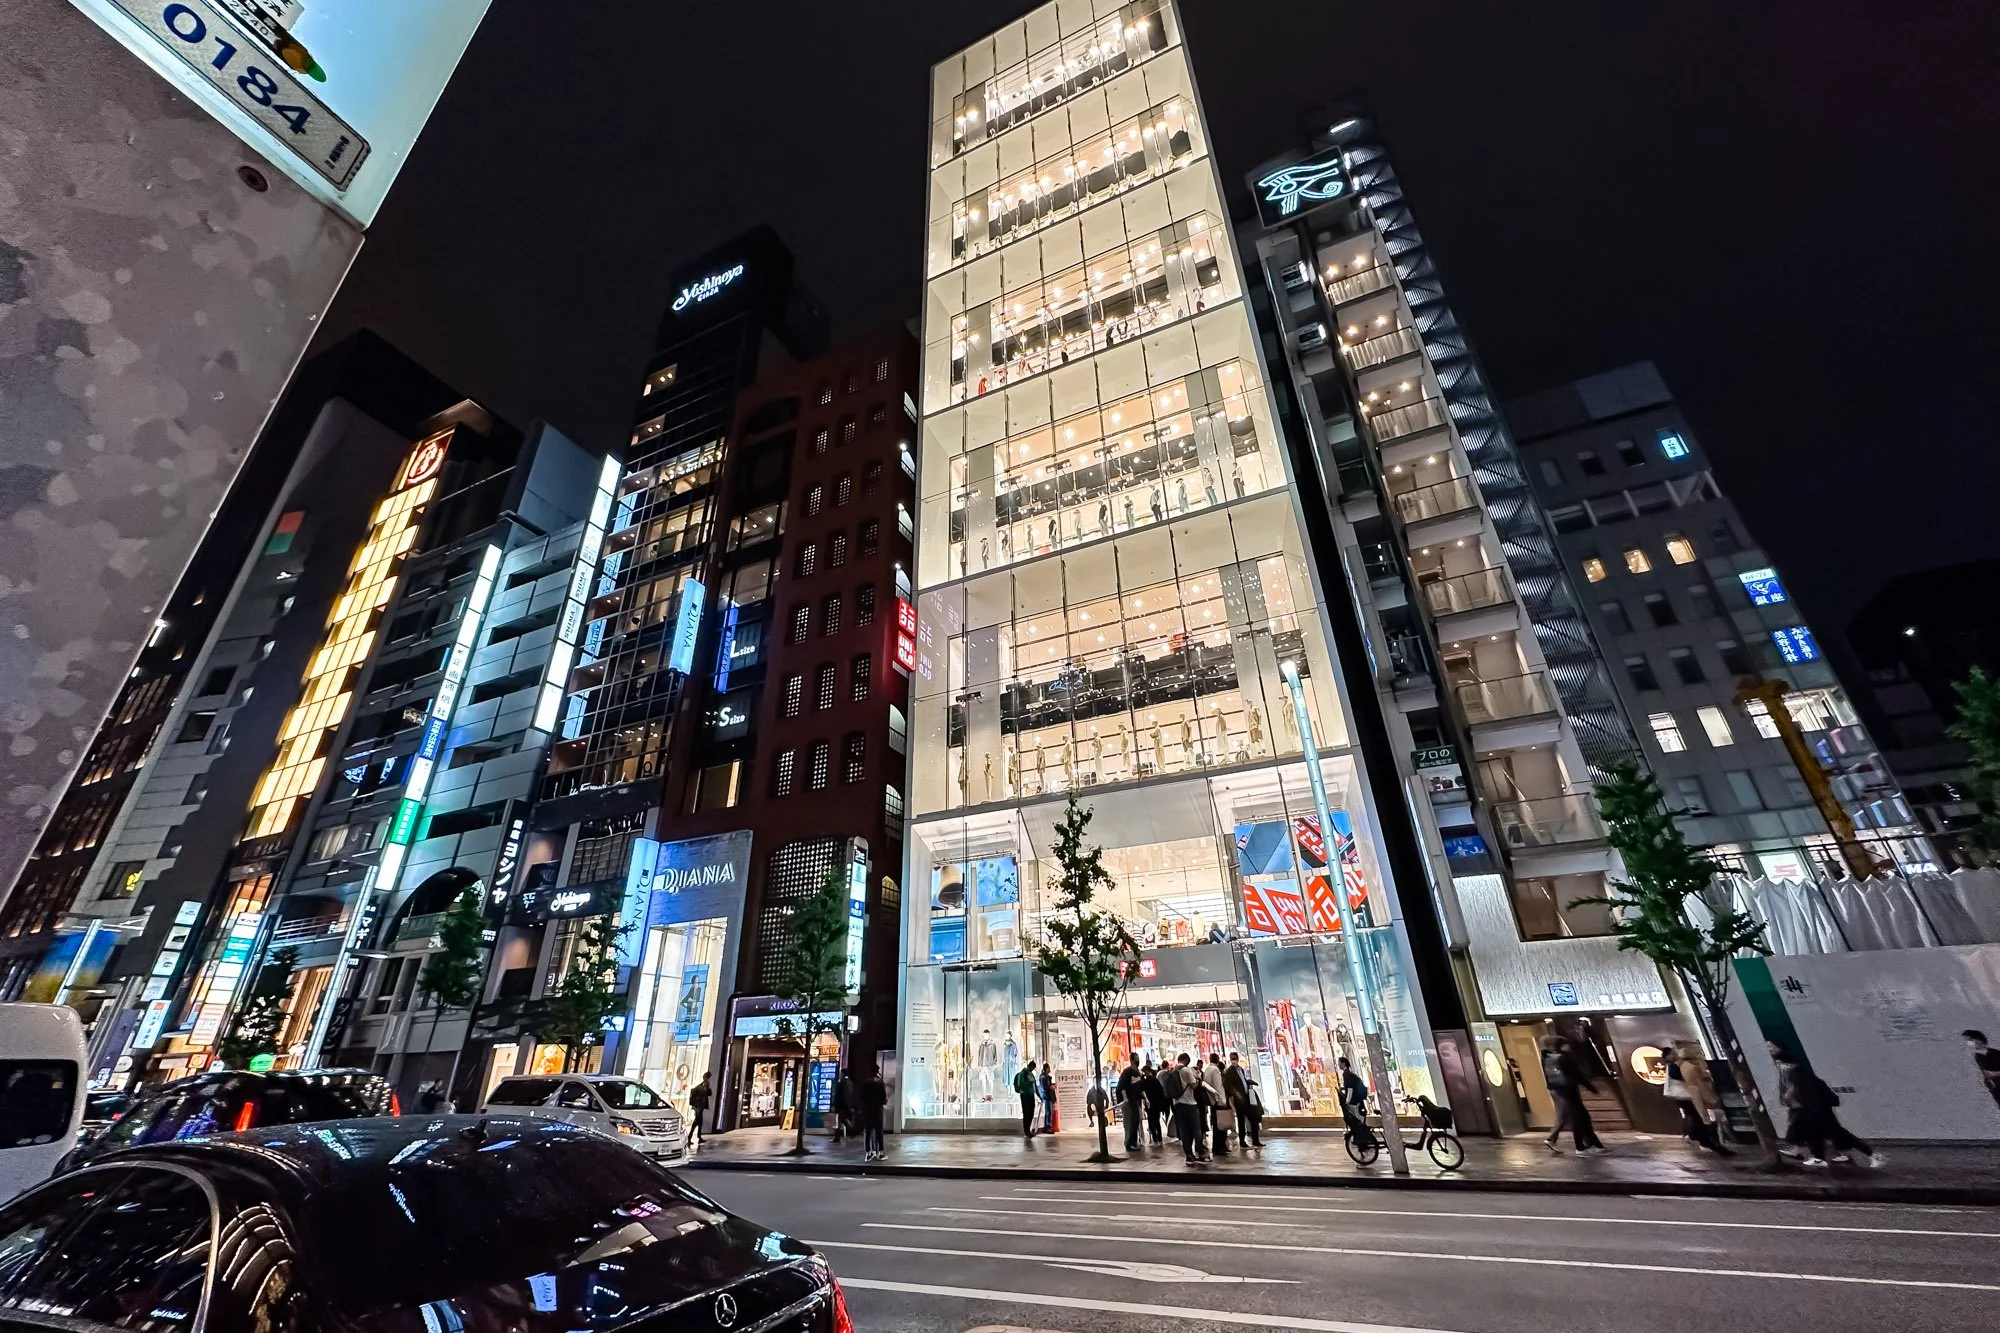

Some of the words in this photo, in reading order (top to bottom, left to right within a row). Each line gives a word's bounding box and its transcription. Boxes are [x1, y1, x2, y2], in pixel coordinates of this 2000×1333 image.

[163, 3, 311, 135] 0184
[671, 264, 744, 311] Yoshinoya
[1755, 593, 1785, 605] 銀座
[564, 610, 575, 639] SHIMA
[684, 603, 698, 648] DIANA
[898, 648, 914, 666] QLO
[899, 634, 913, 653] UNI
[1417, 748, 1450, 761] プロの
[662, 862, 735, 894] DIANA
